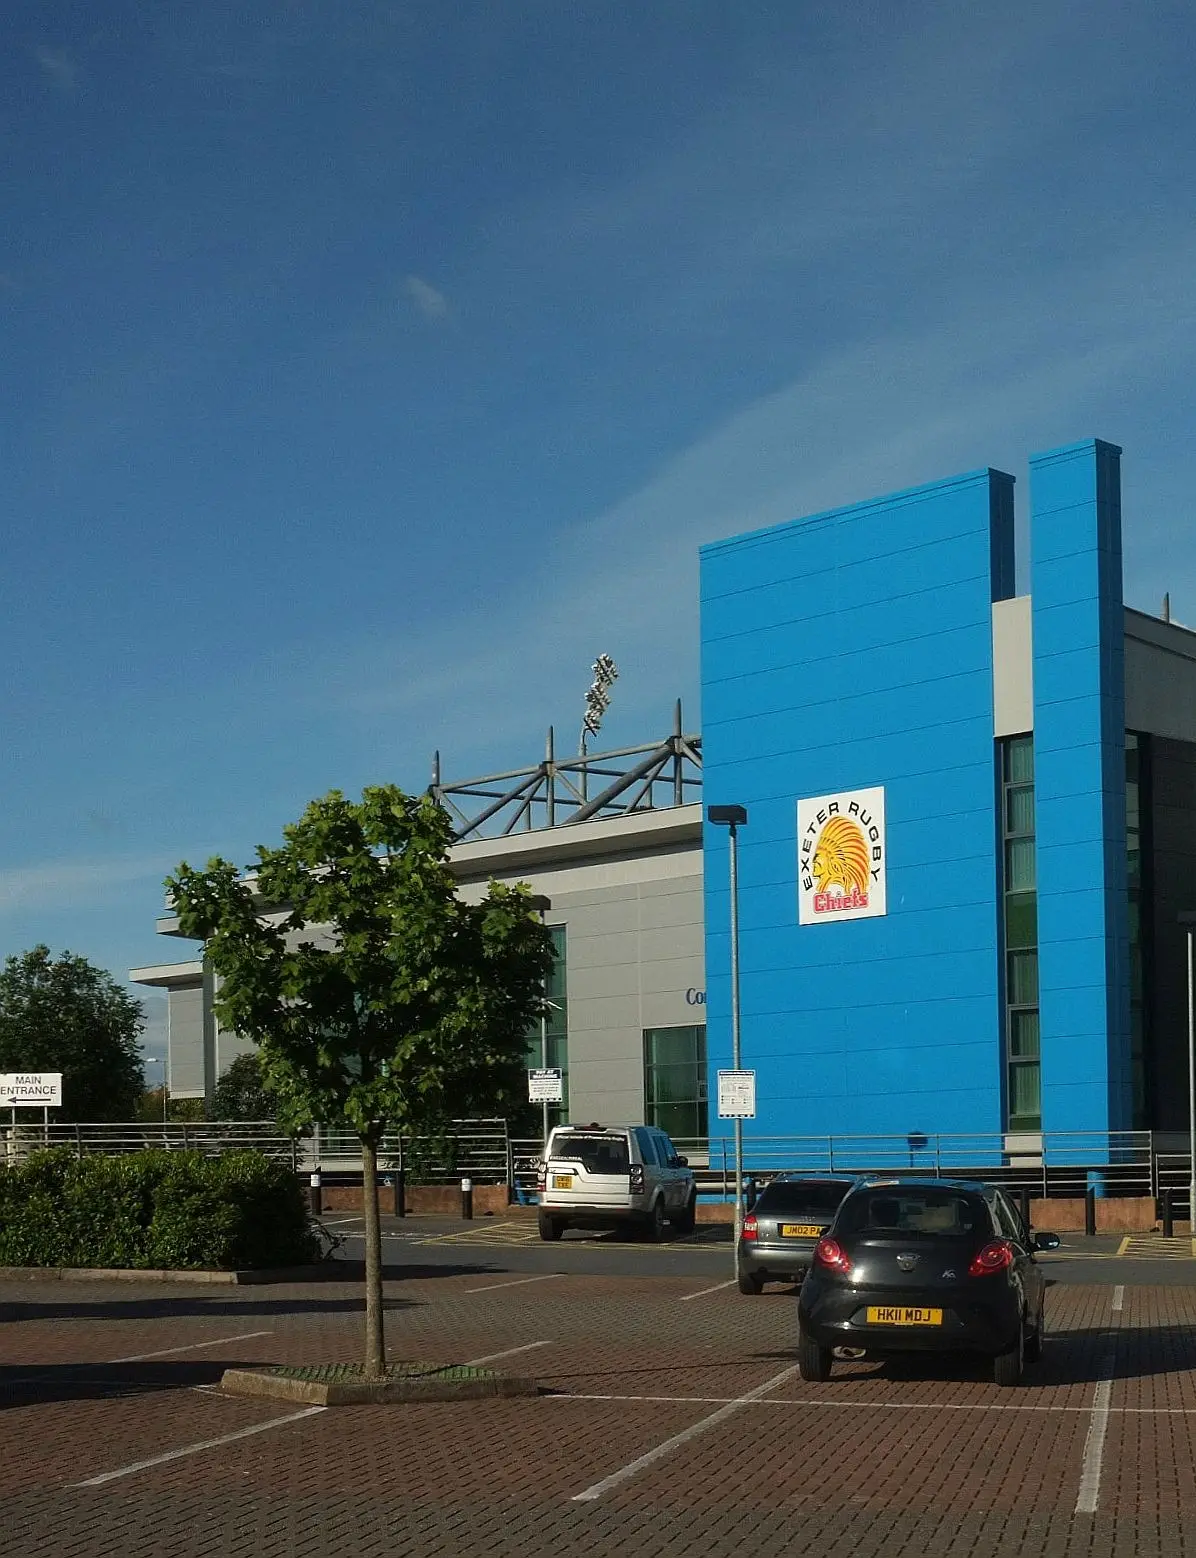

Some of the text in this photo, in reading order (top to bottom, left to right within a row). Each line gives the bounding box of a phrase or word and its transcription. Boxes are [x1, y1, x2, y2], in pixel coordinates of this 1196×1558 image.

[801, 801, 881, 891] EXETER RUGBY
[813, 887, 869, 913] Chiefs
[15, 1076, 42, 1084] MAIN
[0, 1086, 57, 1095] ENTRANCE
[905, 1309, 931, 1322] MDJ
